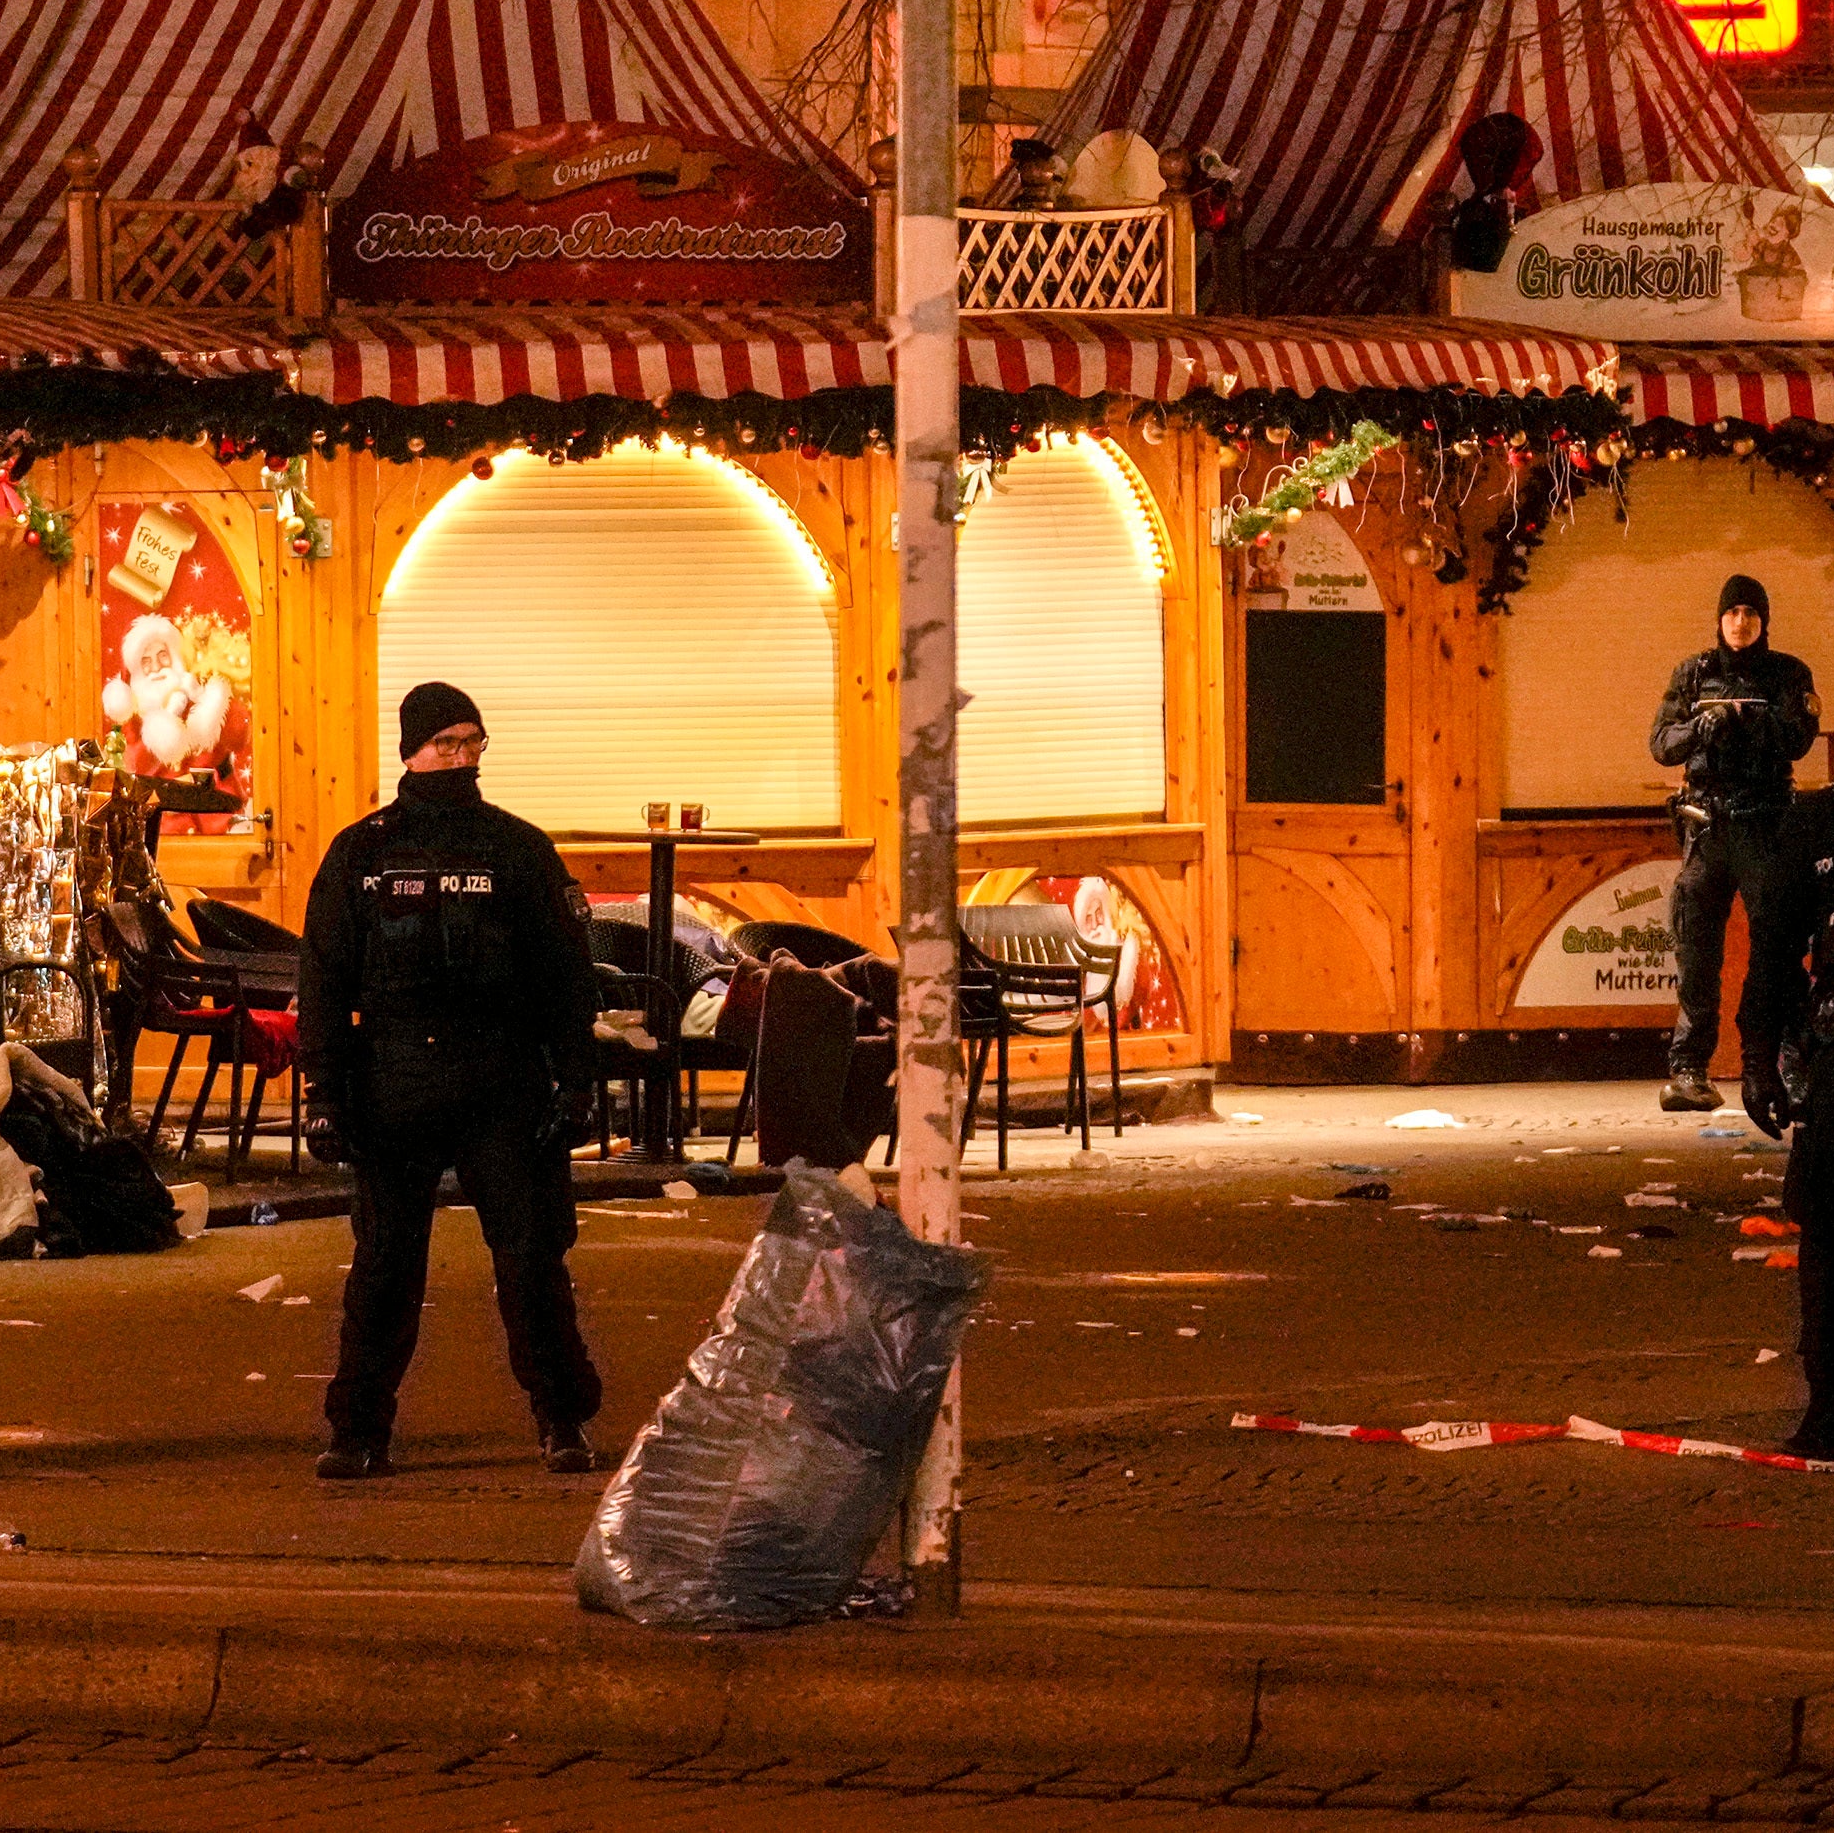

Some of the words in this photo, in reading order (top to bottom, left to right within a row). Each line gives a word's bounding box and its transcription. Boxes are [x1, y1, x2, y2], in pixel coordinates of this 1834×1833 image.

[552, 142, 654, 187] Original
[356, 212, 561, 271] Thüringer
[560, 211, 845, 259] Rostbratwurst
[1582, 215, 1724, 243] Hausgemachter
[1518, 243, 1723, 300] Grünkohl
[137, 526, 178, 561] Frohes
[135, 551, 161, 576] Fest
[440, 875, 493, 893] POIZEI
[1618, 954, 1641, 968] wie
[1596, 969, 1678, 991] Muttern
[1412, 1422, 1483, 1444] POLIZEI
